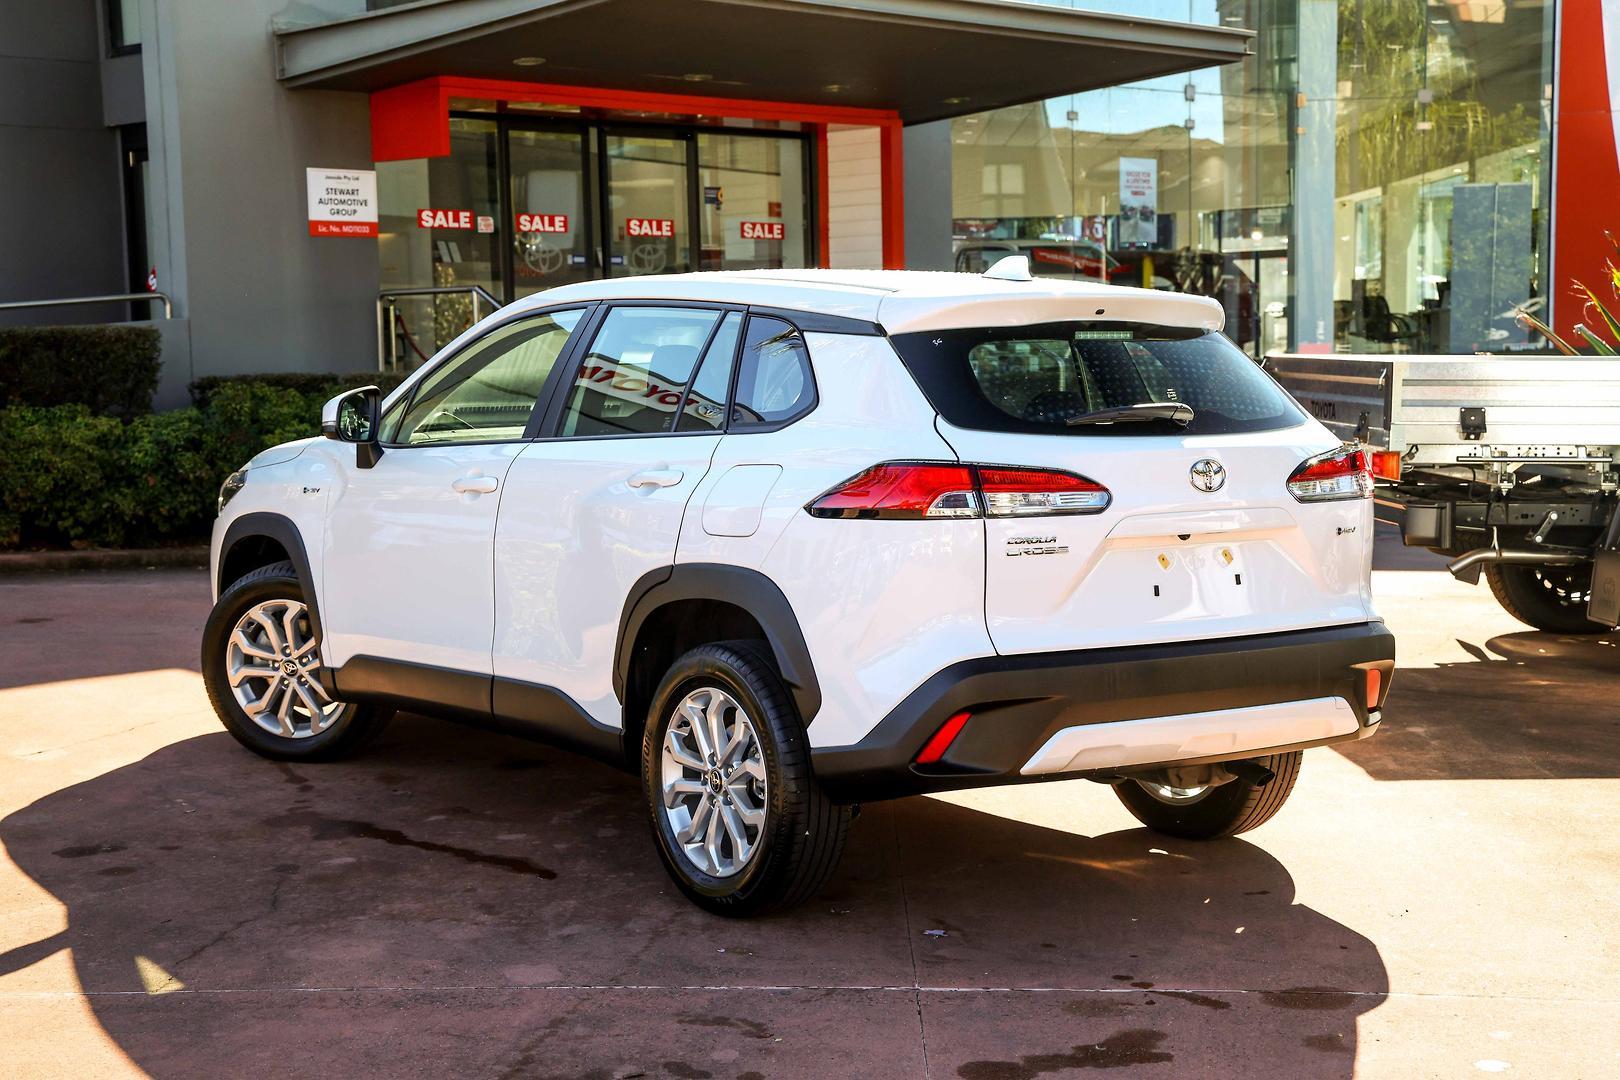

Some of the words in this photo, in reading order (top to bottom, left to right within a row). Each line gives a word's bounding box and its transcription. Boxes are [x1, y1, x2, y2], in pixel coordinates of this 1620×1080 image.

[326, 187, 360, 196] STEWART
[318, 197, 368, 207] AUTOMOTIVE
[329, 208, 358, 216] GROUP
[421, 210, 471, 228] SALE
[519, 215, 566, 232] SALE
[629, 219, 672, 236] SALE
[743, 222, 782, 239] SALE
[1311, 401, 1337, 419] TOYOTA
[1007, 536, 1057, 544] COROLLA
[1006, 546, 1069, 557] CROSS
